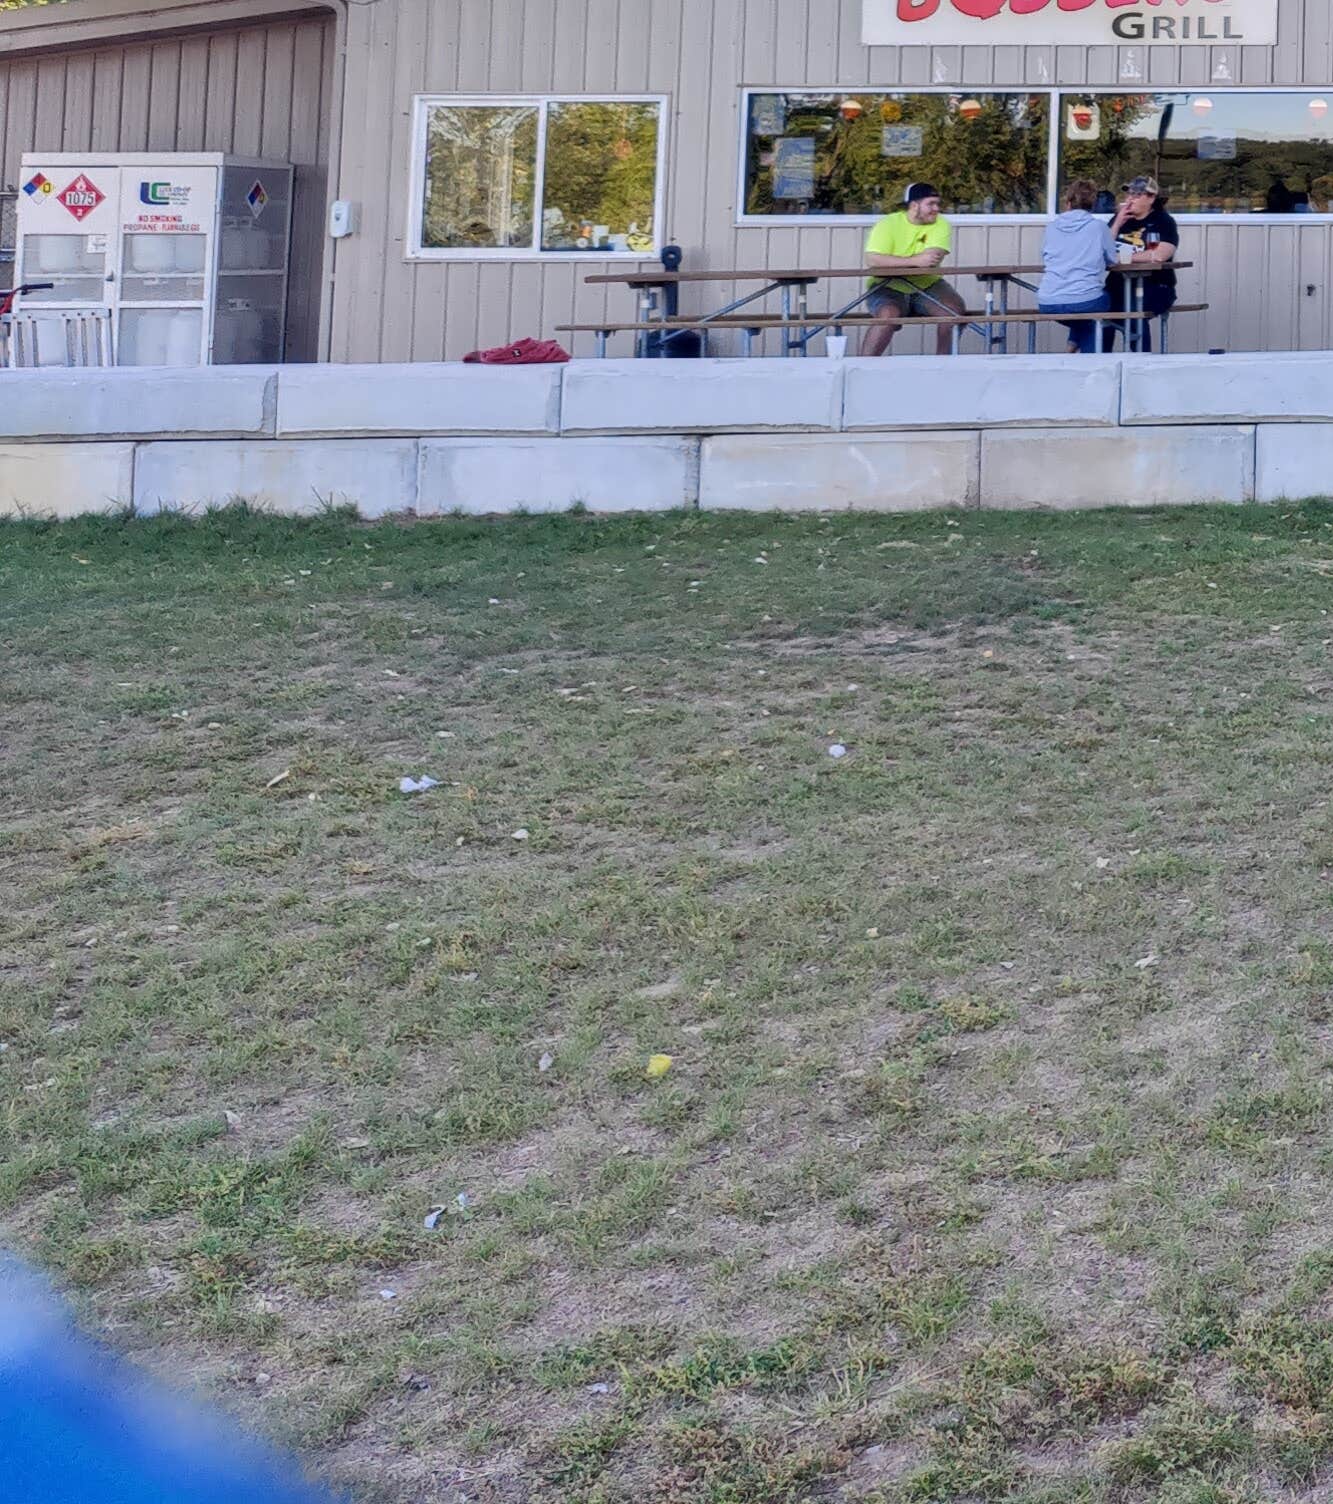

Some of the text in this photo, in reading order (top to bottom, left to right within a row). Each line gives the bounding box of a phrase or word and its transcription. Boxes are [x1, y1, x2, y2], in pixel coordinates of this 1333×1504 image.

[1112, 11, 1243, 39] GRILL
[68, 193, 94, 205] 1075
[123, 224, 158, 232] PROPANE
